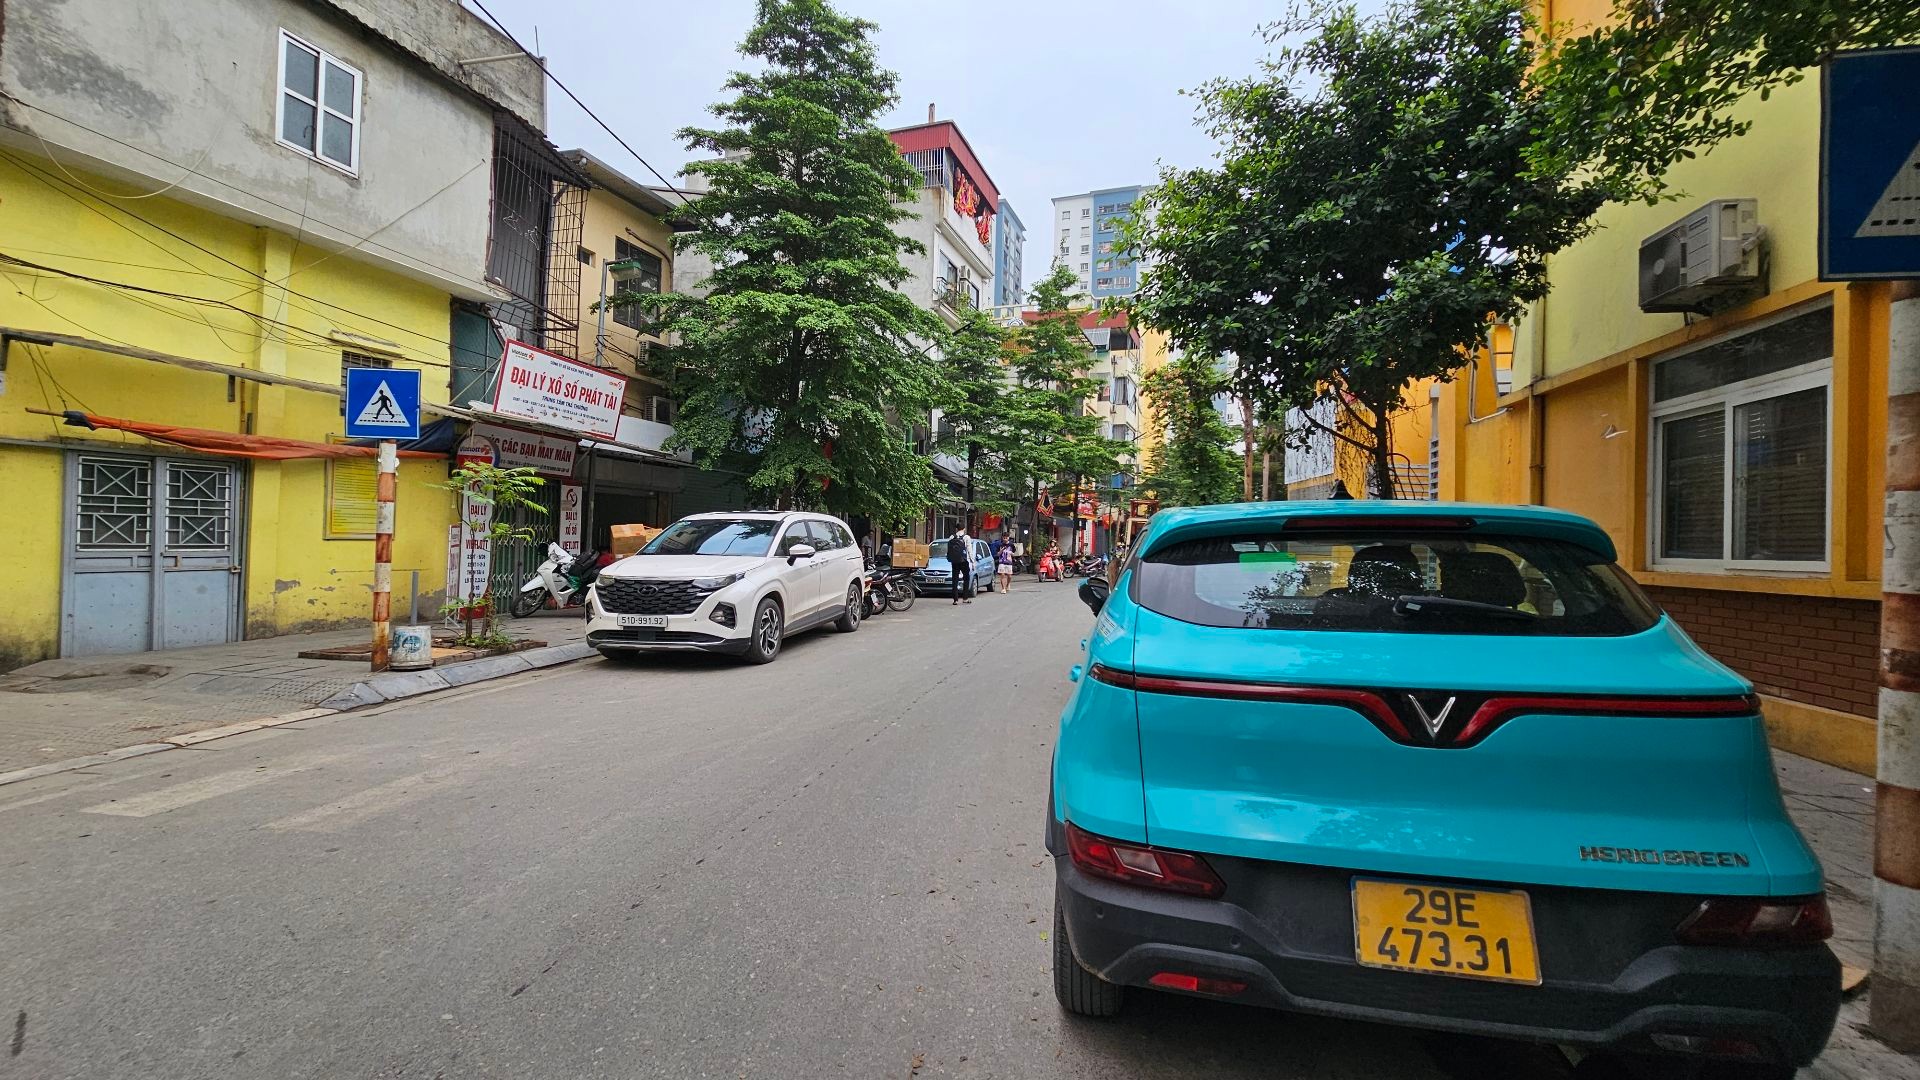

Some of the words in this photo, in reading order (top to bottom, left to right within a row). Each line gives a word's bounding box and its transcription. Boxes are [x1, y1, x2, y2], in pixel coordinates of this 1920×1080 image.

[510, 366, 531, 389] ĐẠI
[532, 371, 547, 391] LÝ
[547, 374, 564, 396] XỔ
[564, 379, 580, 400] SỐ
[578, 386, 603, 406] PHÁT
[603, 392, 618, 411] TÀI
[501, 436, 518, 454] CÁC
[519, 442, 537, 459] BẠN
[537, 446, 554, 460] MAY
[554, 445, 572, 463] MẮN
[621, 616, 664, 625] 51D-991.92
[1578, 845, 1660, 865] HERIO
[1661, 848, 1750, 868] GREEN
[1403, 888, 1480, 929] 29E
[1377, 926, 1512, 975] 473.31
